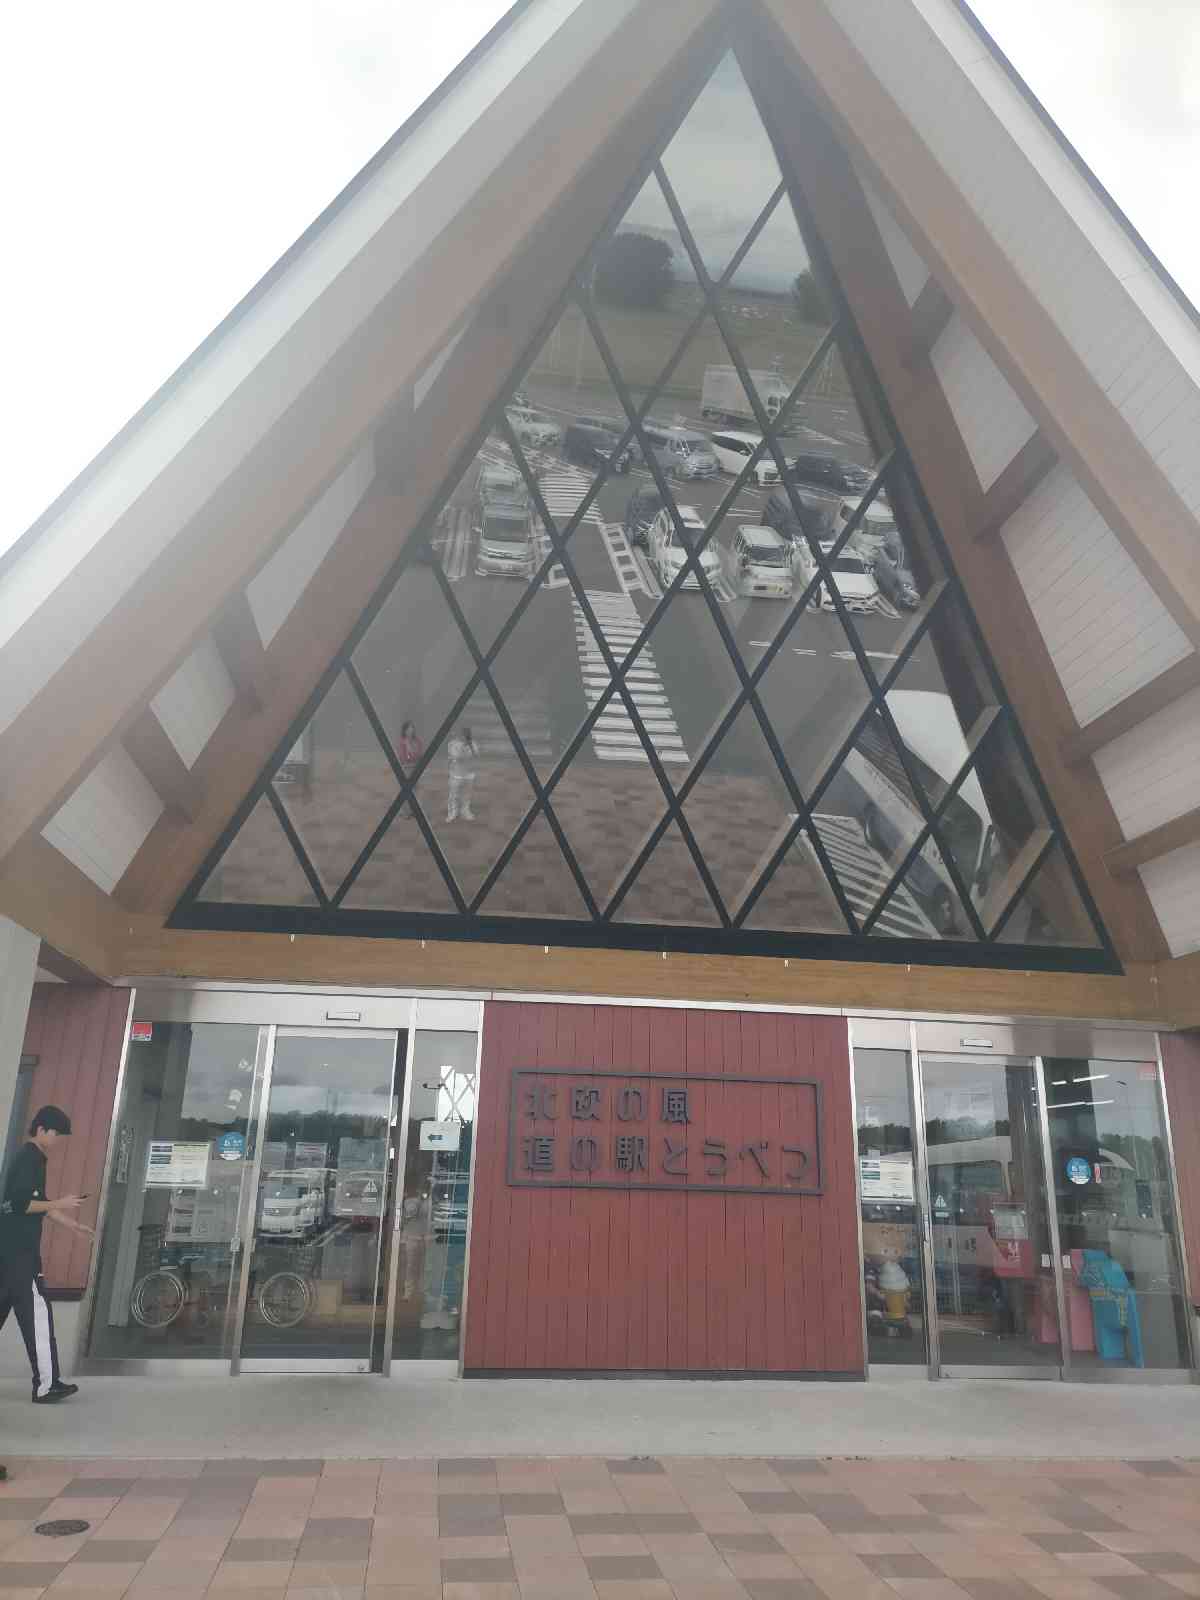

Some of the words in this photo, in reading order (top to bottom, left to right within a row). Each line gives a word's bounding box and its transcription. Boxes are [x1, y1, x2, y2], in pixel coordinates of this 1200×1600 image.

[525, 1086, 690, 1124] 北欧の風
[523, 1135, 808, 1179] 道の駅とうべつ
